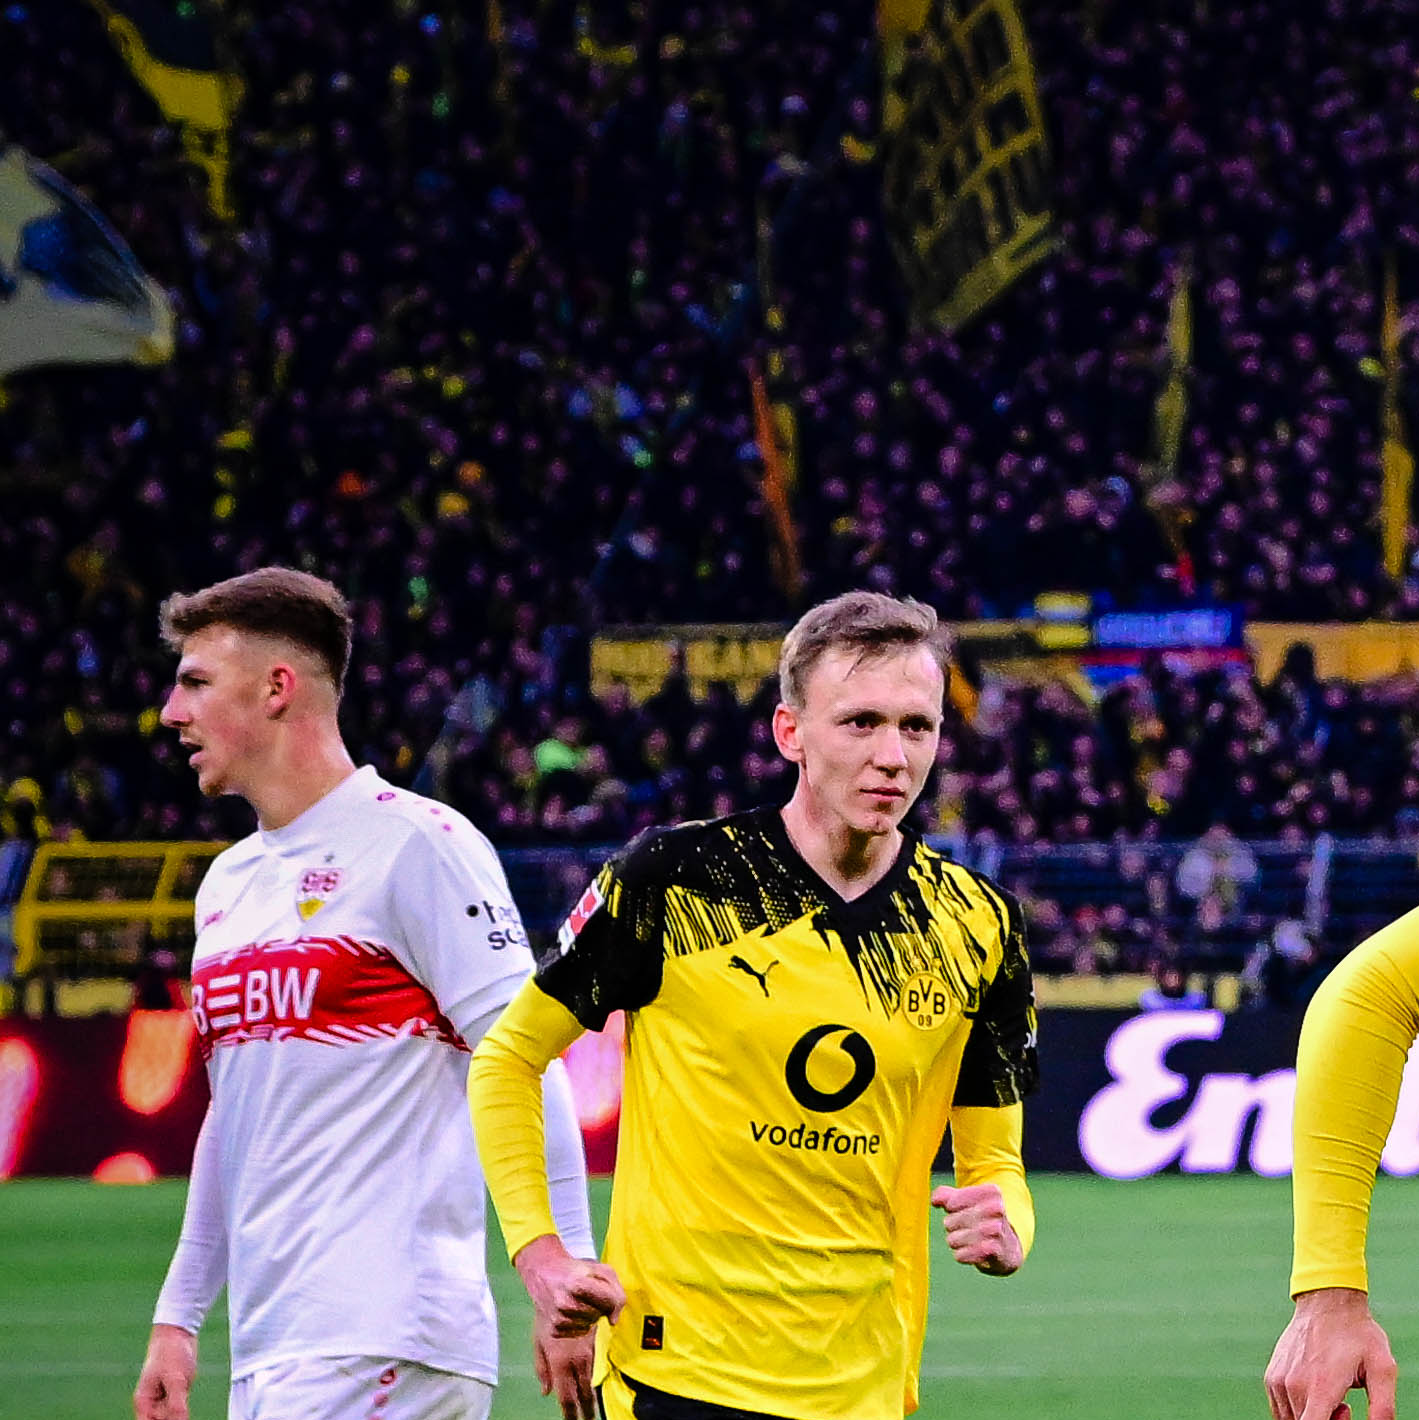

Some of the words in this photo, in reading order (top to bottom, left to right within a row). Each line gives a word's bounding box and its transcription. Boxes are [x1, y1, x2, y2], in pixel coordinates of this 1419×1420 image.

[909, 978, 945, 1015] BVB
[918, 1014, 932, 1027] 09
[750, 1120, 880, 1155] vodafone
